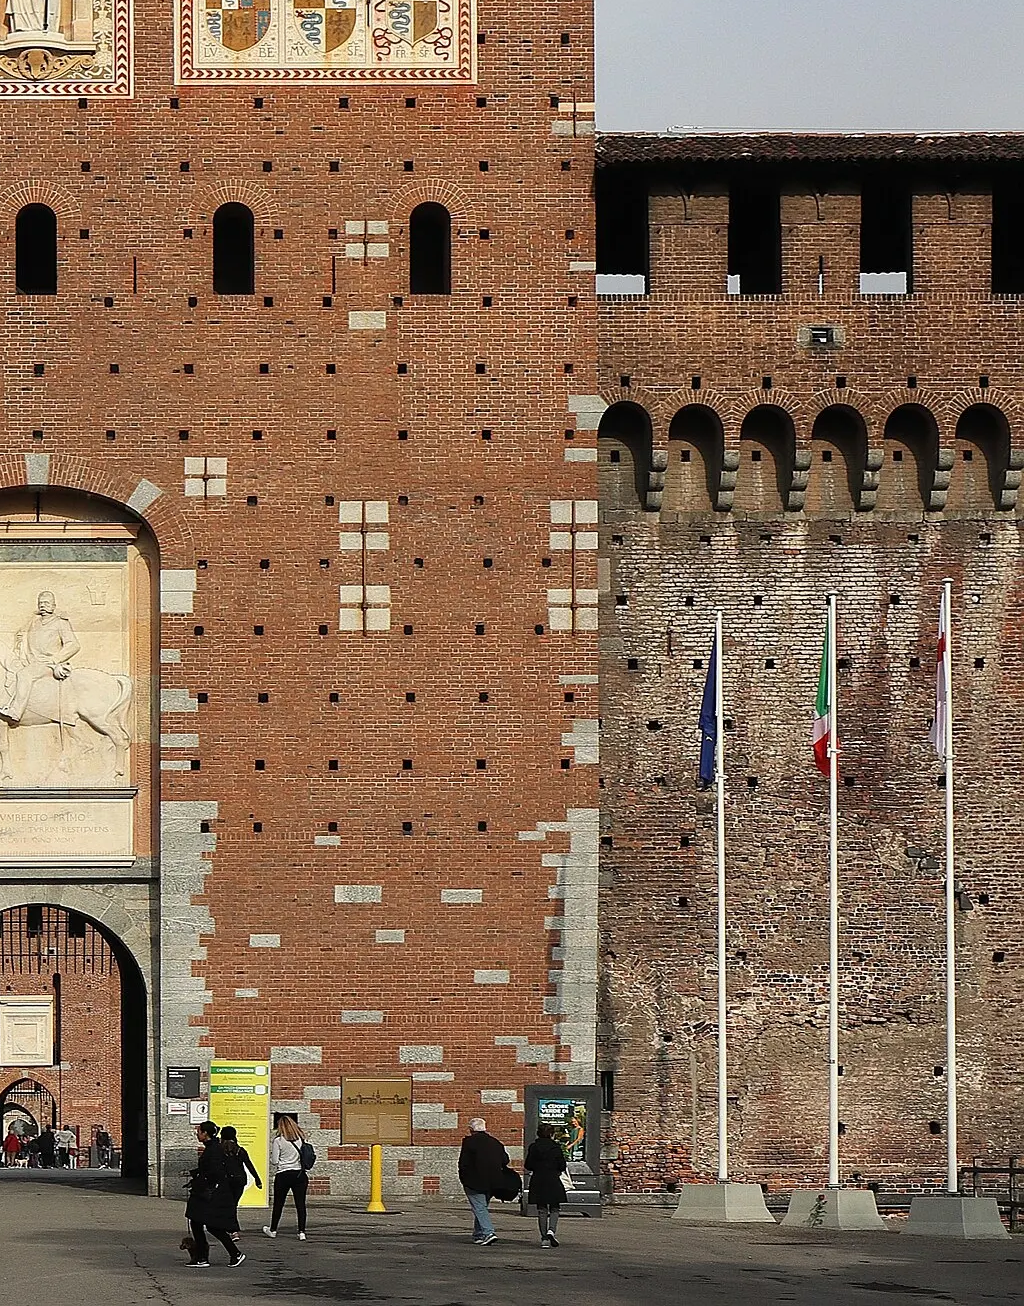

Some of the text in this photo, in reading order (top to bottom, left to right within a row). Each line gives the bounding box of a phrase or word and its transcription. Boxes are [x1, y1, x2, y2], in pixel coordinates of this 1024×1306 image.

[259, 47, 274, 58] BE
[290, 46, 308, 57] MX
[347, 45, 360, 56] SF
[395, 49, 407, 58] FR
[419, 49, 430, 58] SF
[53, 813, 86, 822] PRIMO
